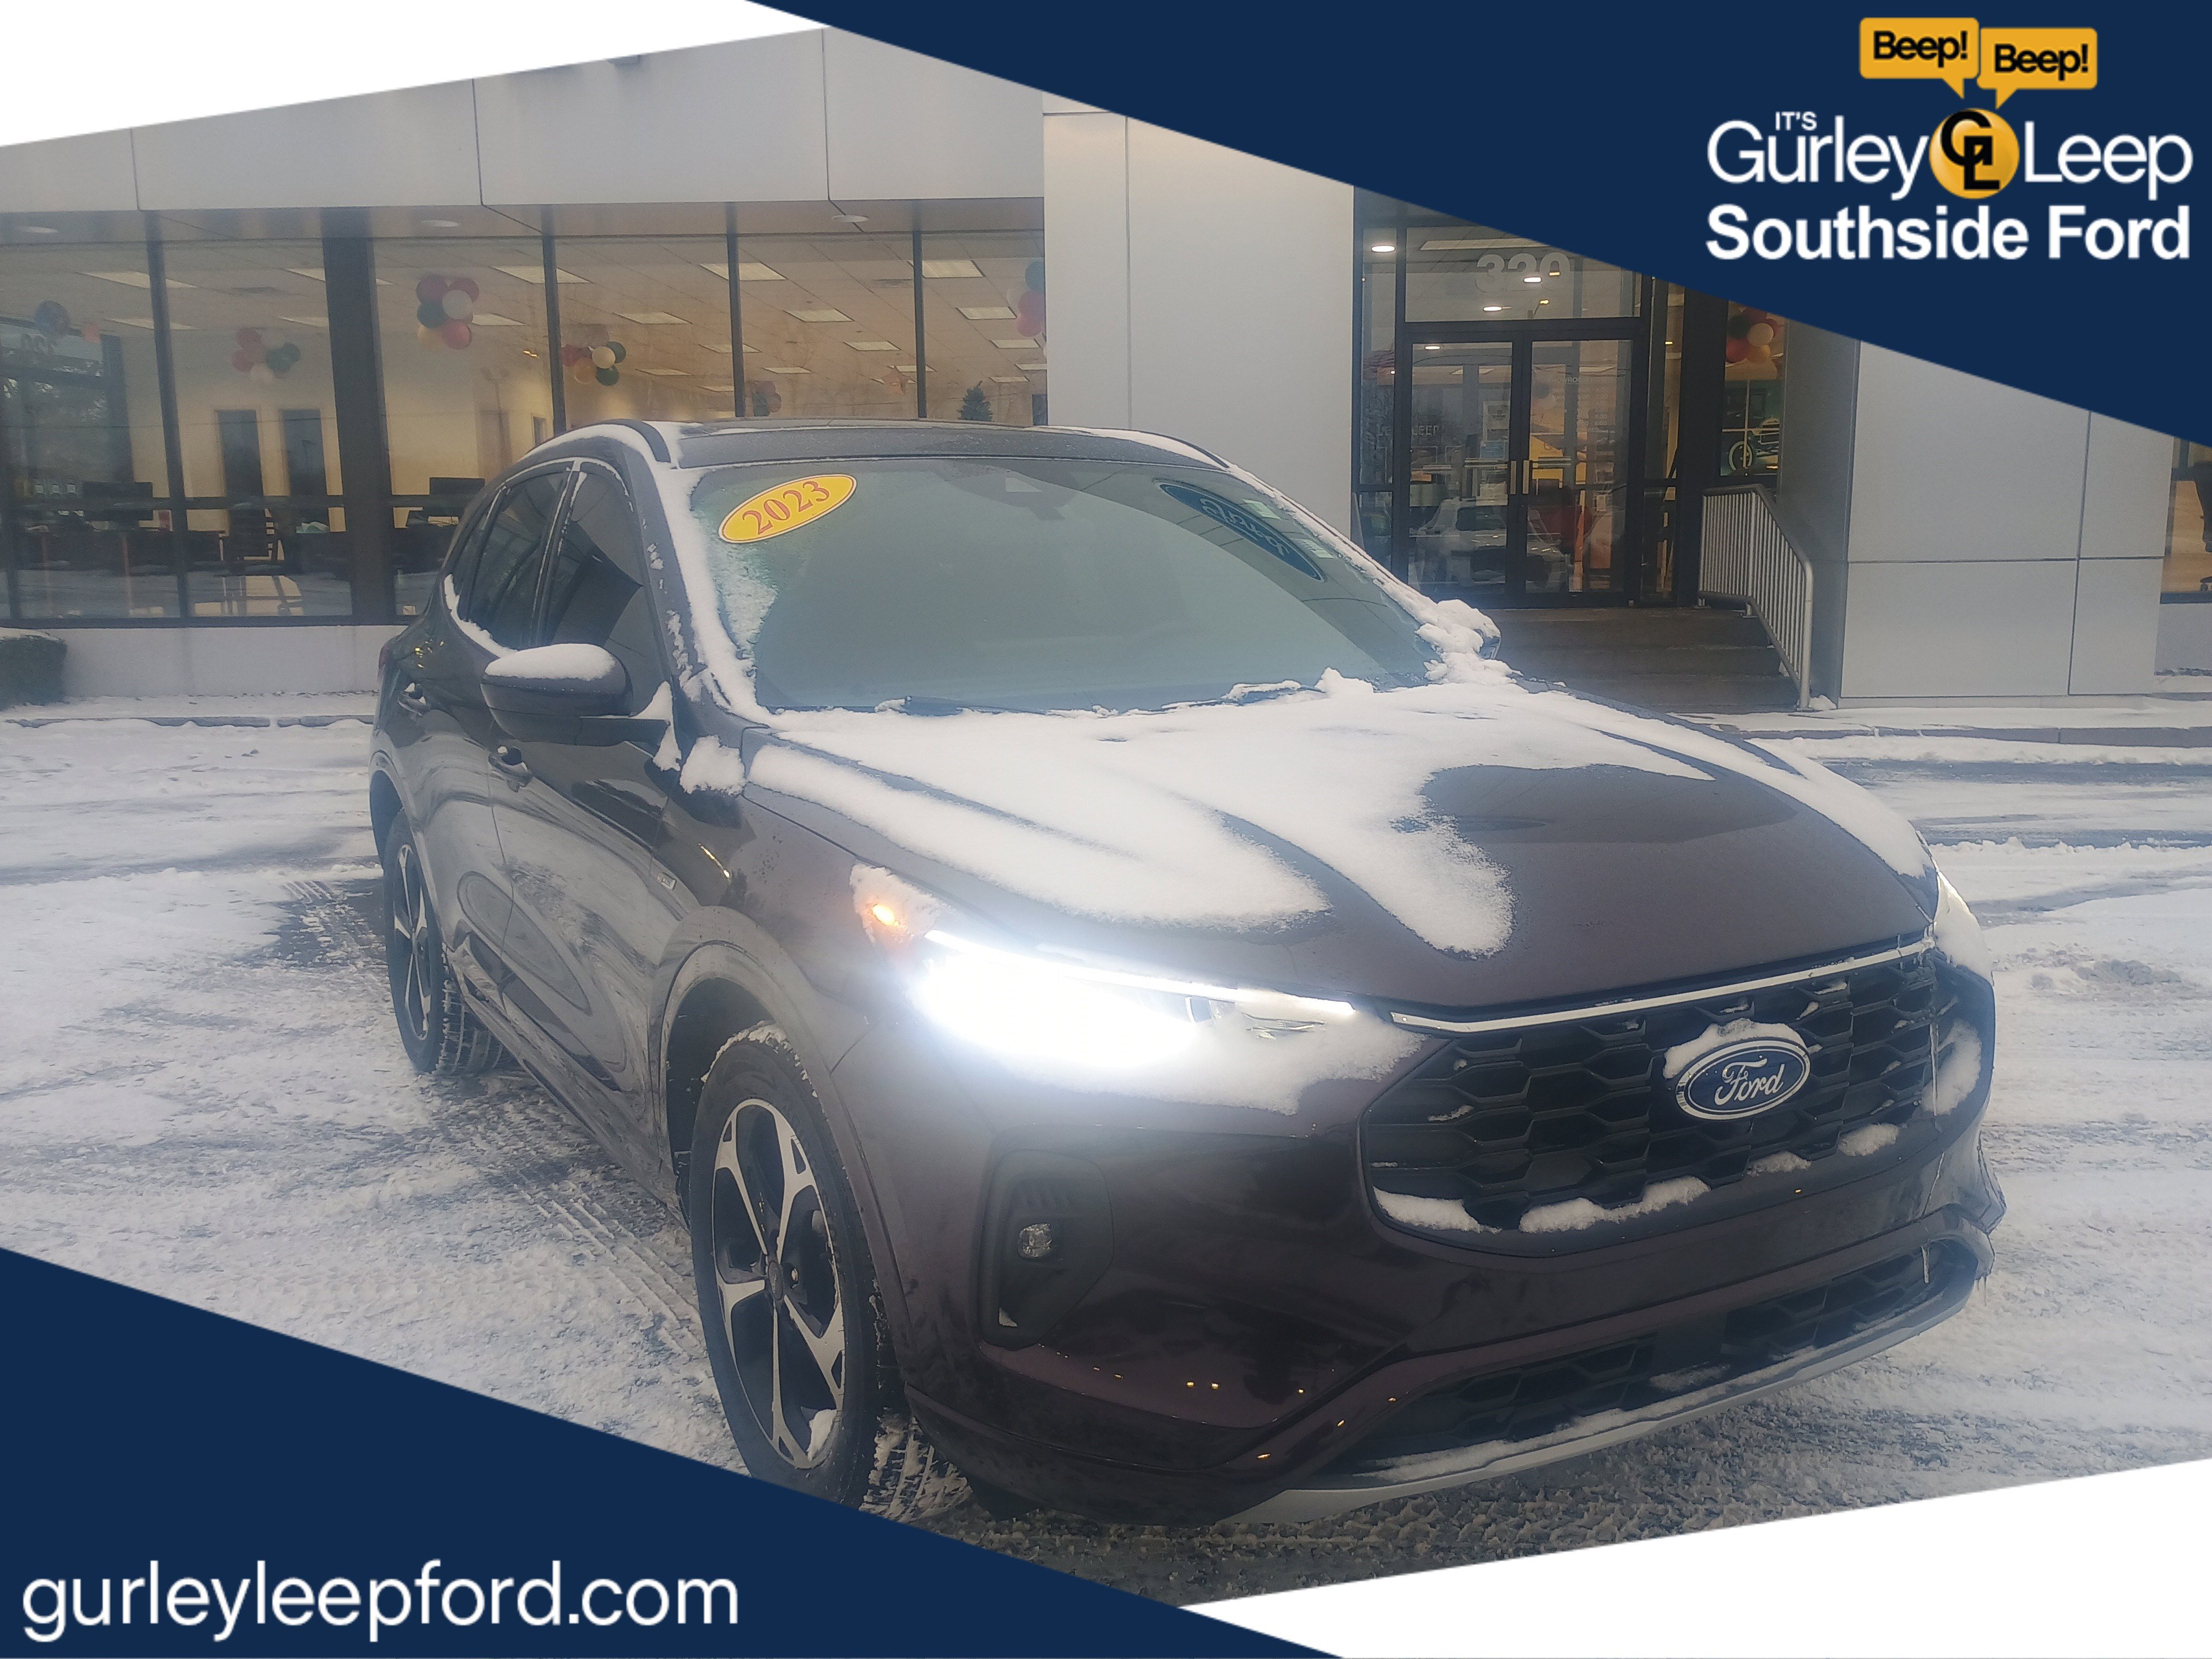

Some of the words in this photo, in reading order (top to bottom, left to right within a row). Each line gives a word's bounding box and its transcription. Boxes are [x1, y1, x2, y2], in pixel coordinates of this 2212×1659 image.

[1475, 252, 1570, 292] 320
[742, 481, 830, 535] 2023
[1715, 1056, 1785, 1105] Ford
